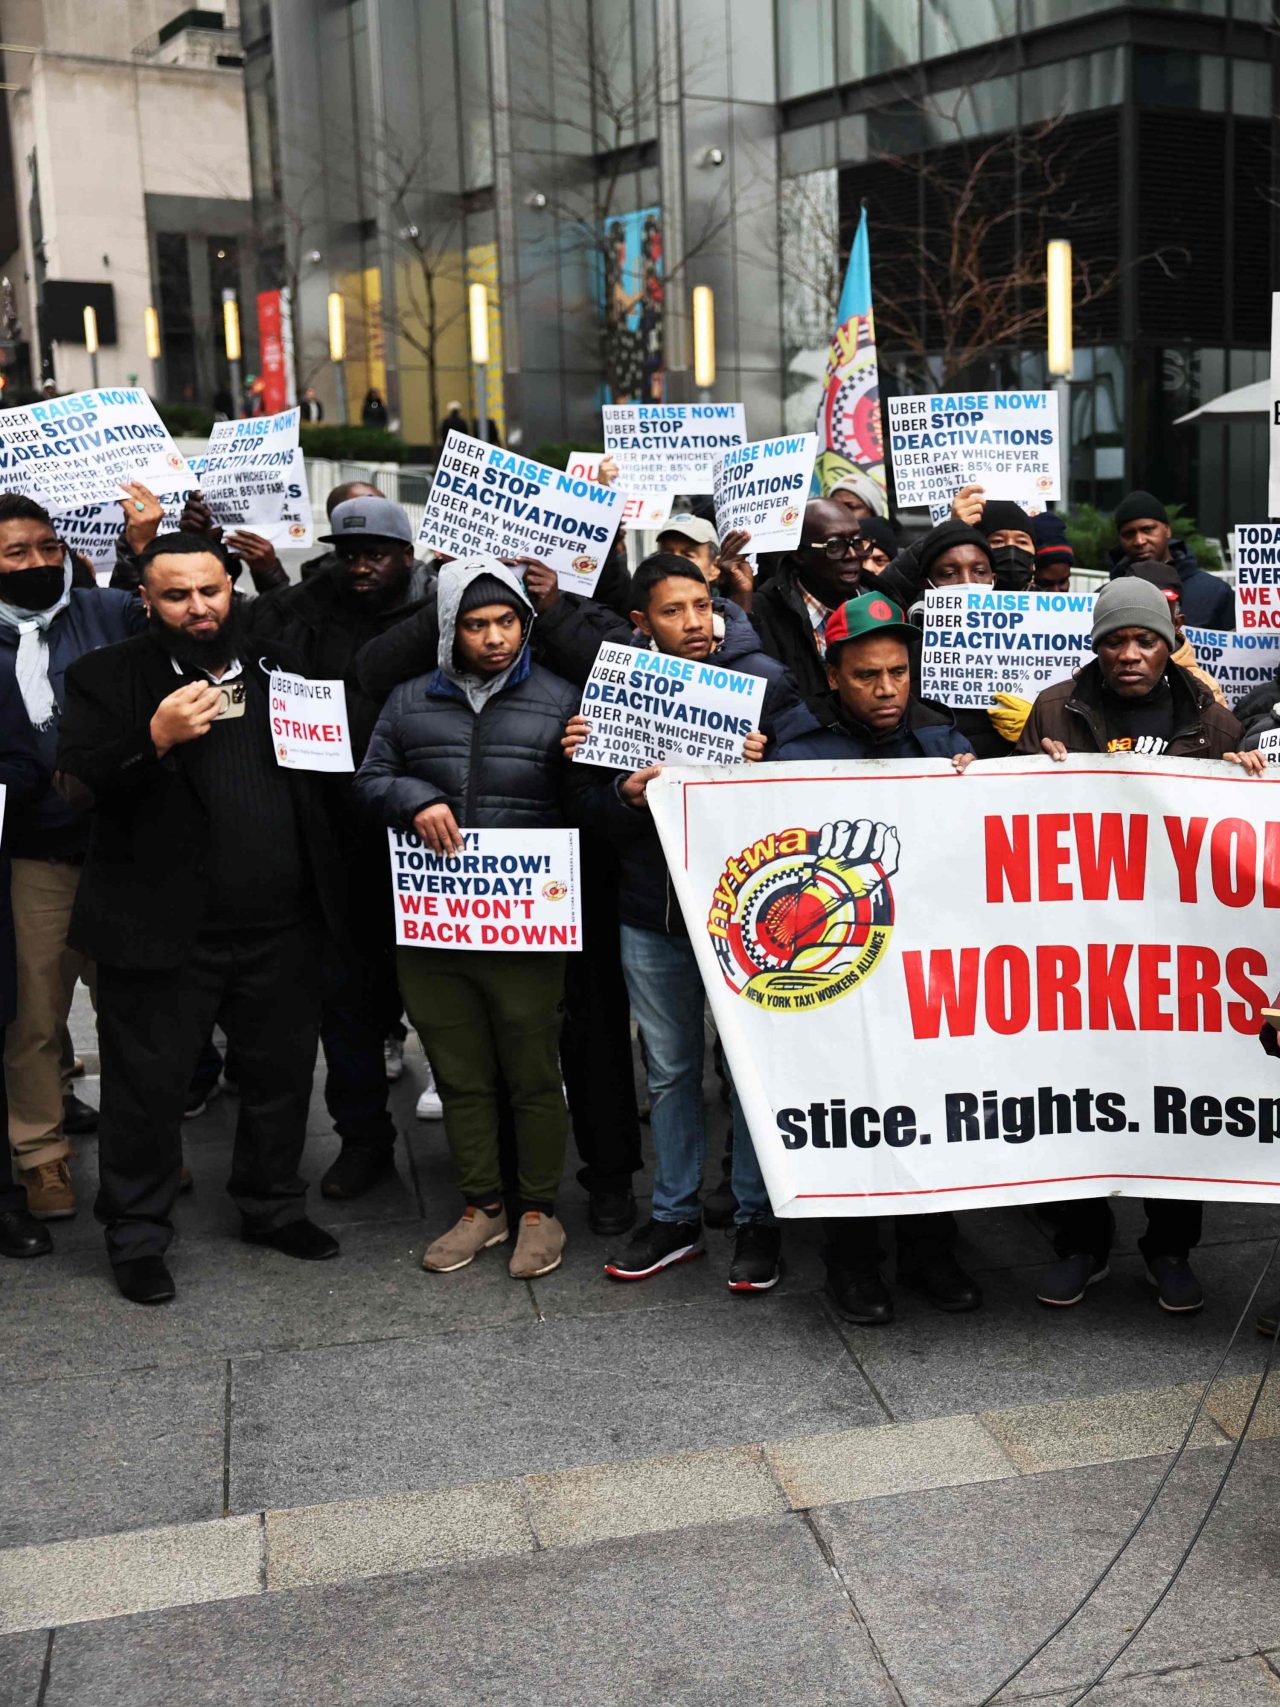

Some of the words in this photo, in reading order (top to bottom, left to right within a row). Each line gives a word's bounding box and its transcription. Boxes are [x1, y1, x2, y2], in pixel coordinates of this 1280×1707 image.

[31, 393, 98, 422] RAISE
[99, 391, 144, 406] NOW!
[891, 402, 925, 414] UBER
[931, 395, 988, 412] RAISE
[995, 394, 1046, 409] NOW!
[3, 430, 42, 444] UBER
[41, 412, 98, 438] STOP
[892, 419, 927, 432] UBER
[931, 412, 983, 429] STOP
[14, 424, 166, 461] DEACTIVATIONS
[893, 430, 1053, 450] DEACTIVATIONS
[442, 455, 480, 479] UBER
[482, 467, 540, 499] STOP
[448, 437, 485, 461] UBER
[489, 450, 552, 486] RAISE
[556, 475, 616, 507] NOW!
[436, 470, 609, 543] DEACTIVATIONS
[927, 597, 962, 609] UBER
[967, 594, 1029, 611] RAISE
[1037, 596, 1092, 612] NOW!
[1239, 588, 1272, 605] WE
[926, 615, 962, 627] UBER
[966, 612, 1023, 629] STOP
[592, 666, 625, 685] UBER
[629, 671, 684, 697] STOP
[599, 649, 631, 666] UBER
[635, 653, 695, 681] RAISE
[699, 667, 755, 696] NOW!
[272, 676, 292, 694] UBER
[294, 682, 332, 699] DRIVER
[272, 698, 286, 712] ON
[585, 683, 752, 737] DEACTIVATIONS
[273, 717, 342, 742] STRIKE!
[393, 830, 479, 851] TOY!
[395, 851, 551, 874] TOMORROW!
[985, 812, 1149, 904] NEW
[397, 873, 532, 896] EVERYDAY!
[707, 827, 808, 939] nytwa
[399, 894, 438, 916] WE
[446, 898, 534, 919] WON'T
[403, 920, 472, 944] BACK
[481, 925, 577, 945] DOWN!
[746, 986, 764, 1005] NEW
[767, 994, 791, 1008] YORK
[793, 994, 815, 1007] TAXI
[816, 970, 860, 1001] WORKERS
[857, 930, 885, 975] ALLIANCE
[902, 943, 1276, 1039] WORKERS
[776, 1098, 930, 1150] stice.
[946, 1087, 1138, 1145] Rights.
